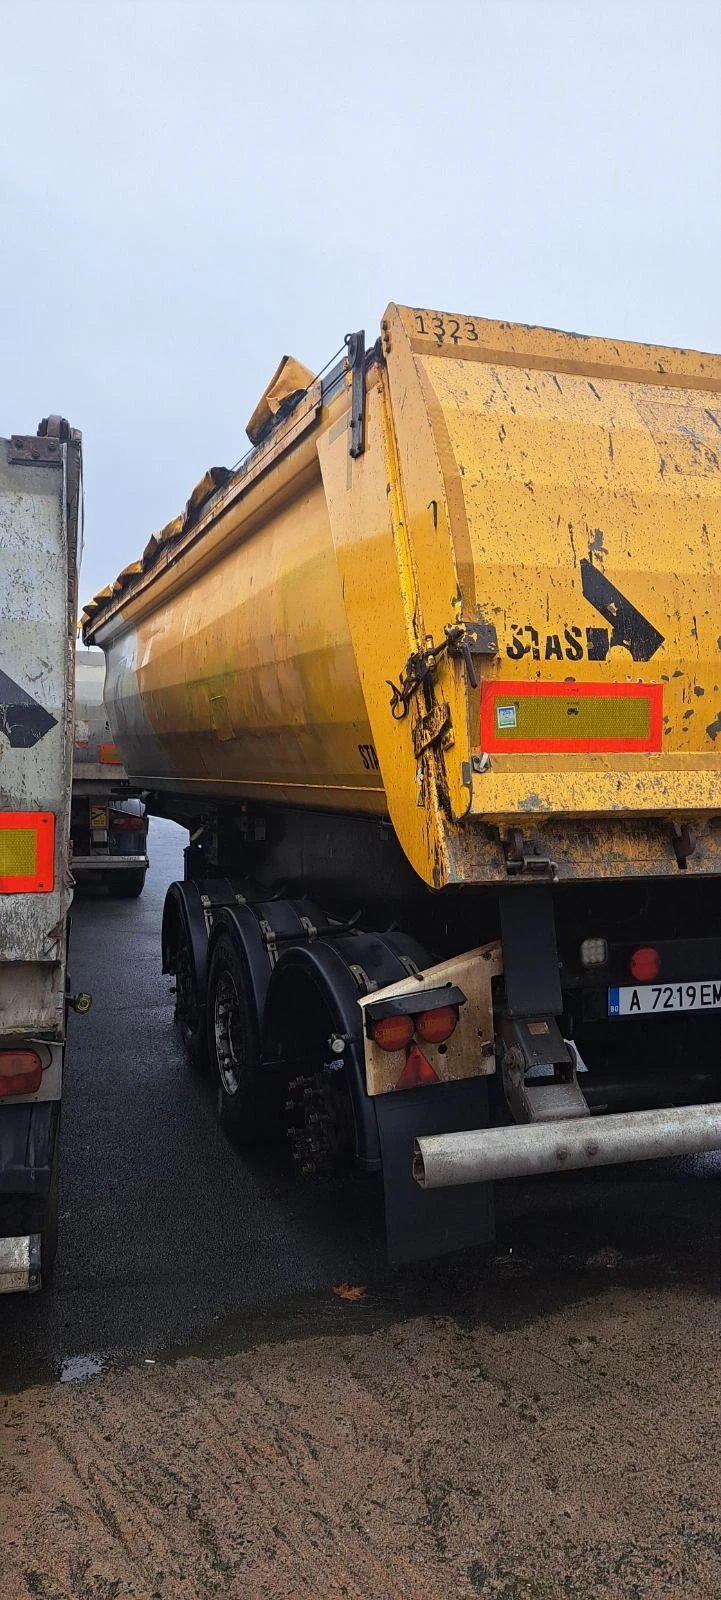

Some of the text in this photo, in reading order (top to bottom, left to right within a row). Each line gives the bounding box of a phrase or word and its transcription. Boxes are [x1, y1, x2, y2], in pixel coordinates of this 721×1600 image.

[415, 315, 479, 342] 1323
[506, 624, 583, 661] STAS
[629, 989, 641, 1011] A
